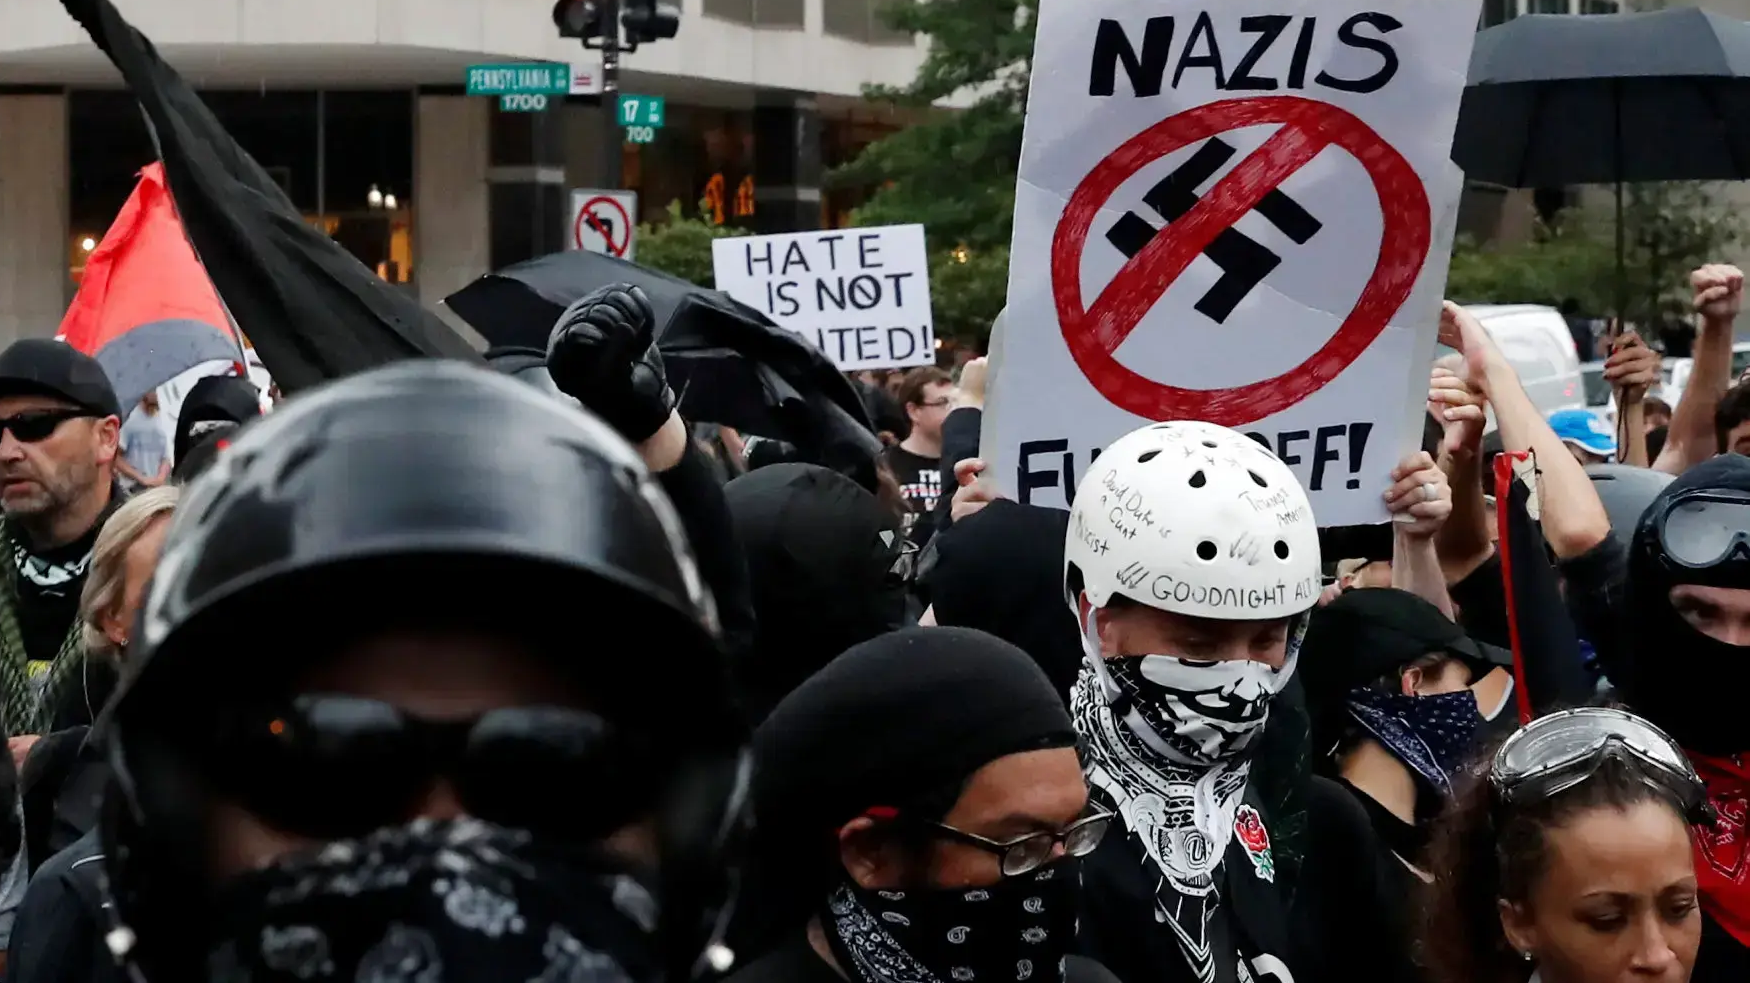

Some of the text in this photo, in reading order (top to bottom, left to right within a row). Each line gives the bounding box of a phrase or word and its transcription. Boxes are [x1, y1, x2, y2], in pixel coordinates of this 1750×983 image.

[1089, 11, 1403, 98] NAZIS
[469, 68, 551, 91] PENNSYLVANIA
[502, 94, 547, 110] 1700
[622, 100, 639, 123] 17
[626, 126, 654, 142] 700
[746, 234, 883, 276] HATE
[766, 273, 913, 316] IS NOT
[817, 325, 932, 362] ITED!
[1017, 423, 1374, 505] FU FF!
[1152, 574, 1286, 609] GOODNIGHT
